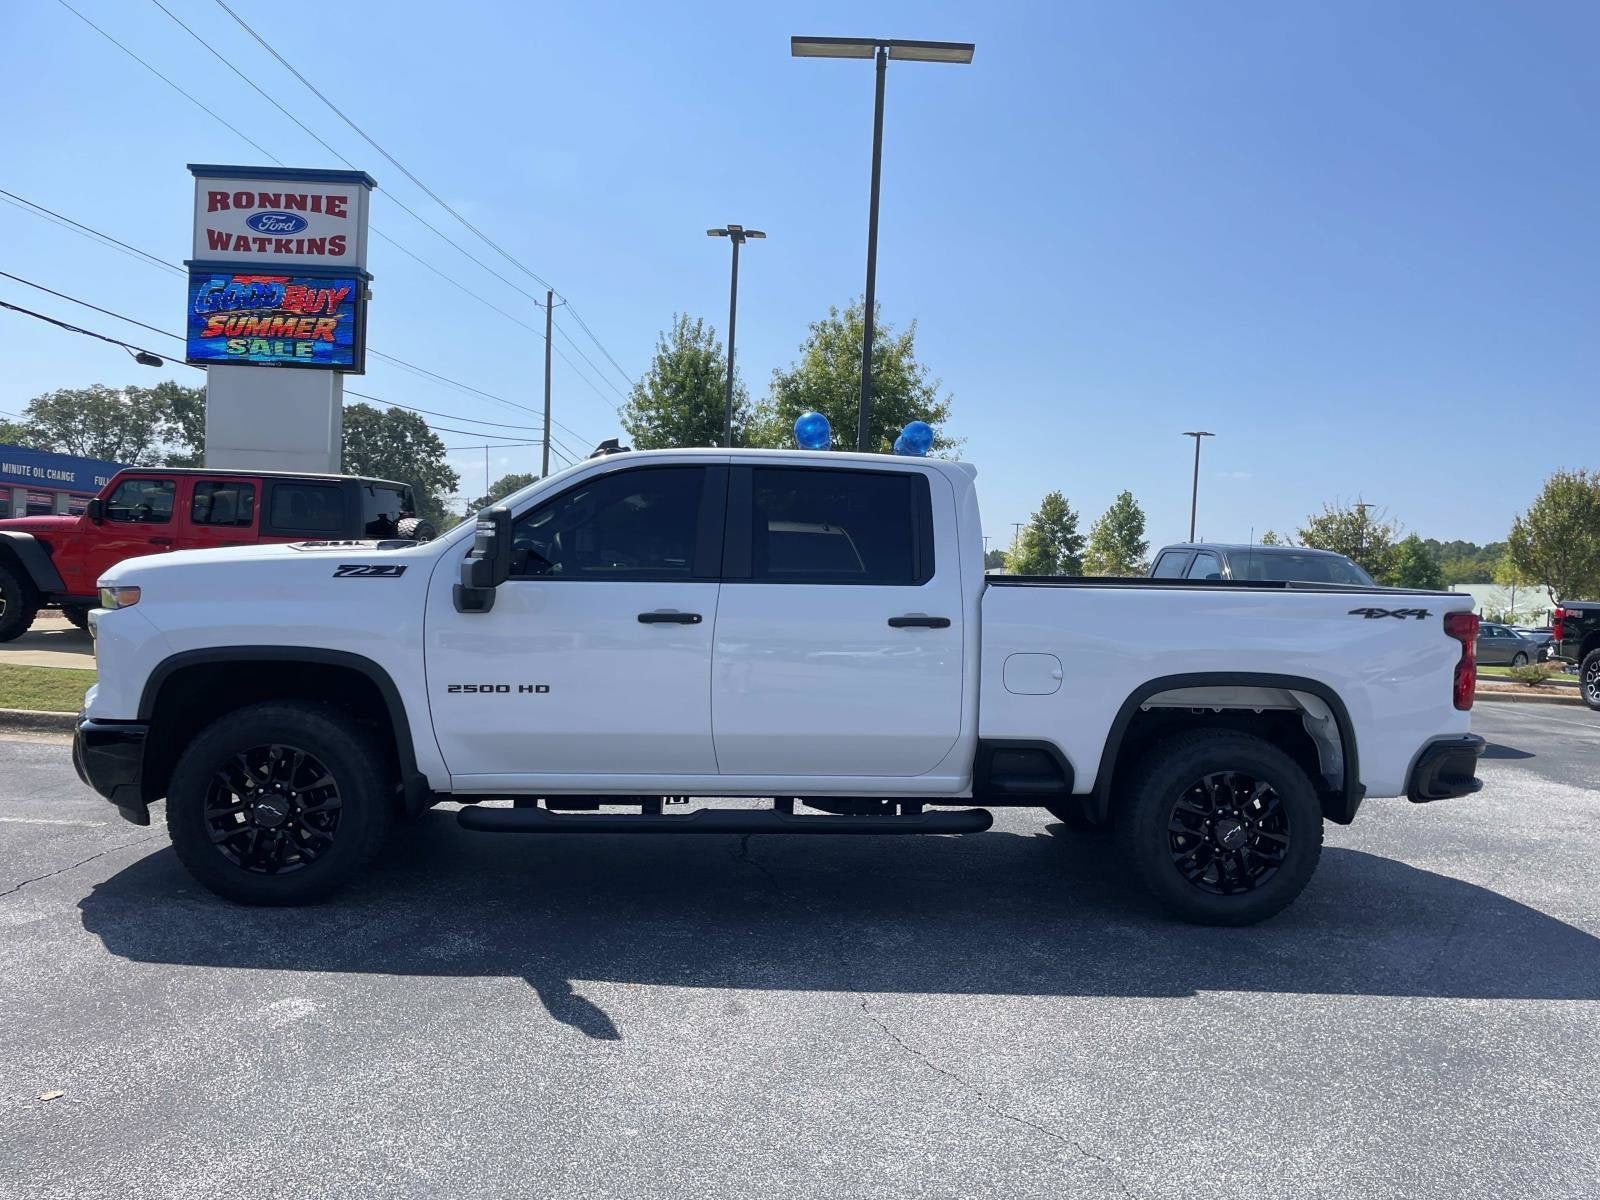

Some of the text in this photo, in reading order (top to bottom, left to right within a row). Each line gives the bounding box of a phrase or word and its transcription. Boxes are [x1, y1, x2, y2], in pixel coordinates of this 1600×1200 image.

[207, 191, 348, 219] RONNIE
[258, 215, 296, 231] Ford
[206, 228, 347, 256] WATKINS
[200, 315, 338, 343] SUMMER
[226, 338, 314, 357] SALE
[2, 463, 76, 482] MINUTE OIL CHANGE
[447, 684, 550, 694] 2500 HD
